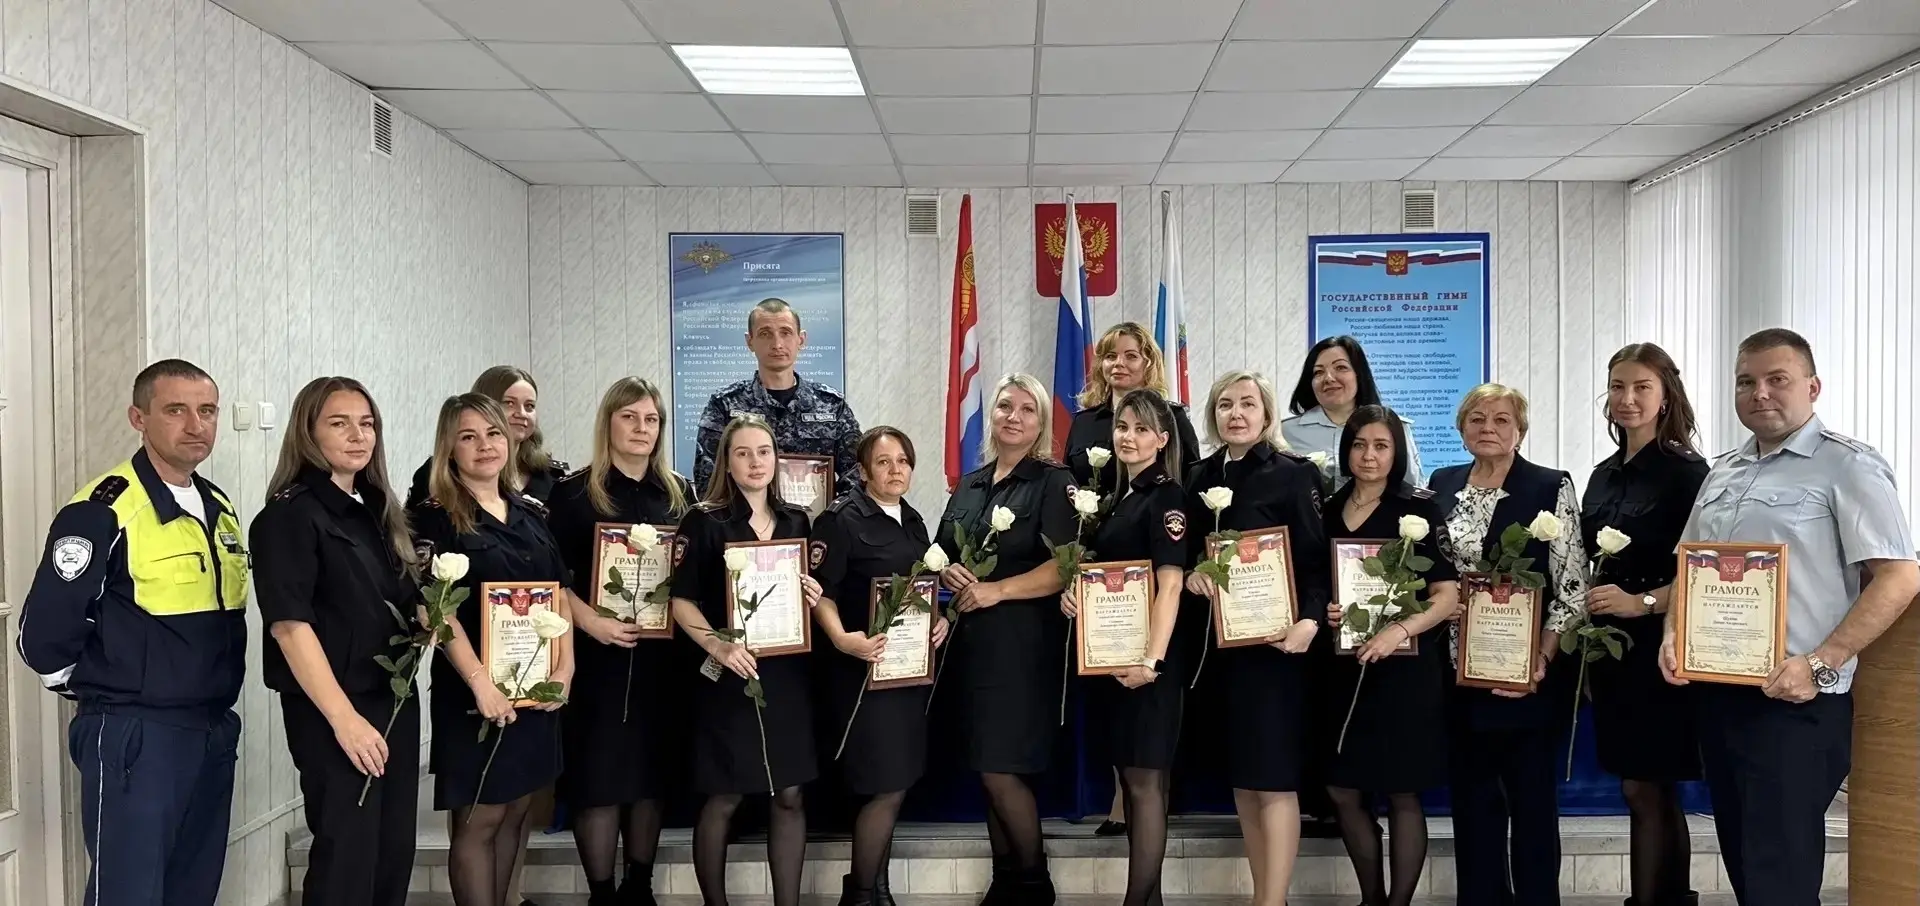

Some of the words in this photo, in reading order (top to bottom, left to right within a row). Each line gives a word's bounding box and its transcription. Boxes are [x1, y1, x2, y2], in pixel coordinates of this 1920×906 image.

[743, 261, 781, 272] Присяга
[1321, 292, 1429, 302] ГОСУДАРСТВЕННЫЙ
[1436, 291, 1468, 300] ГИМН
[1331, 304, 1392, 313] Российской
[1401, 303, 1459, 313] Федерации
[1230, 564, 1274, 576] ГРАМОТА
[1704, 584, 1760, 596] ГРАМОТА
[1095, 594, 1137, 604] ГРАМОТА
[1480, 605, 1522, 616] ГРАМОТА
[1703, 602, 1759, 610] НАГРАЖДАЕТСЯ
[501, 619, 531, 629] ГРАМО
